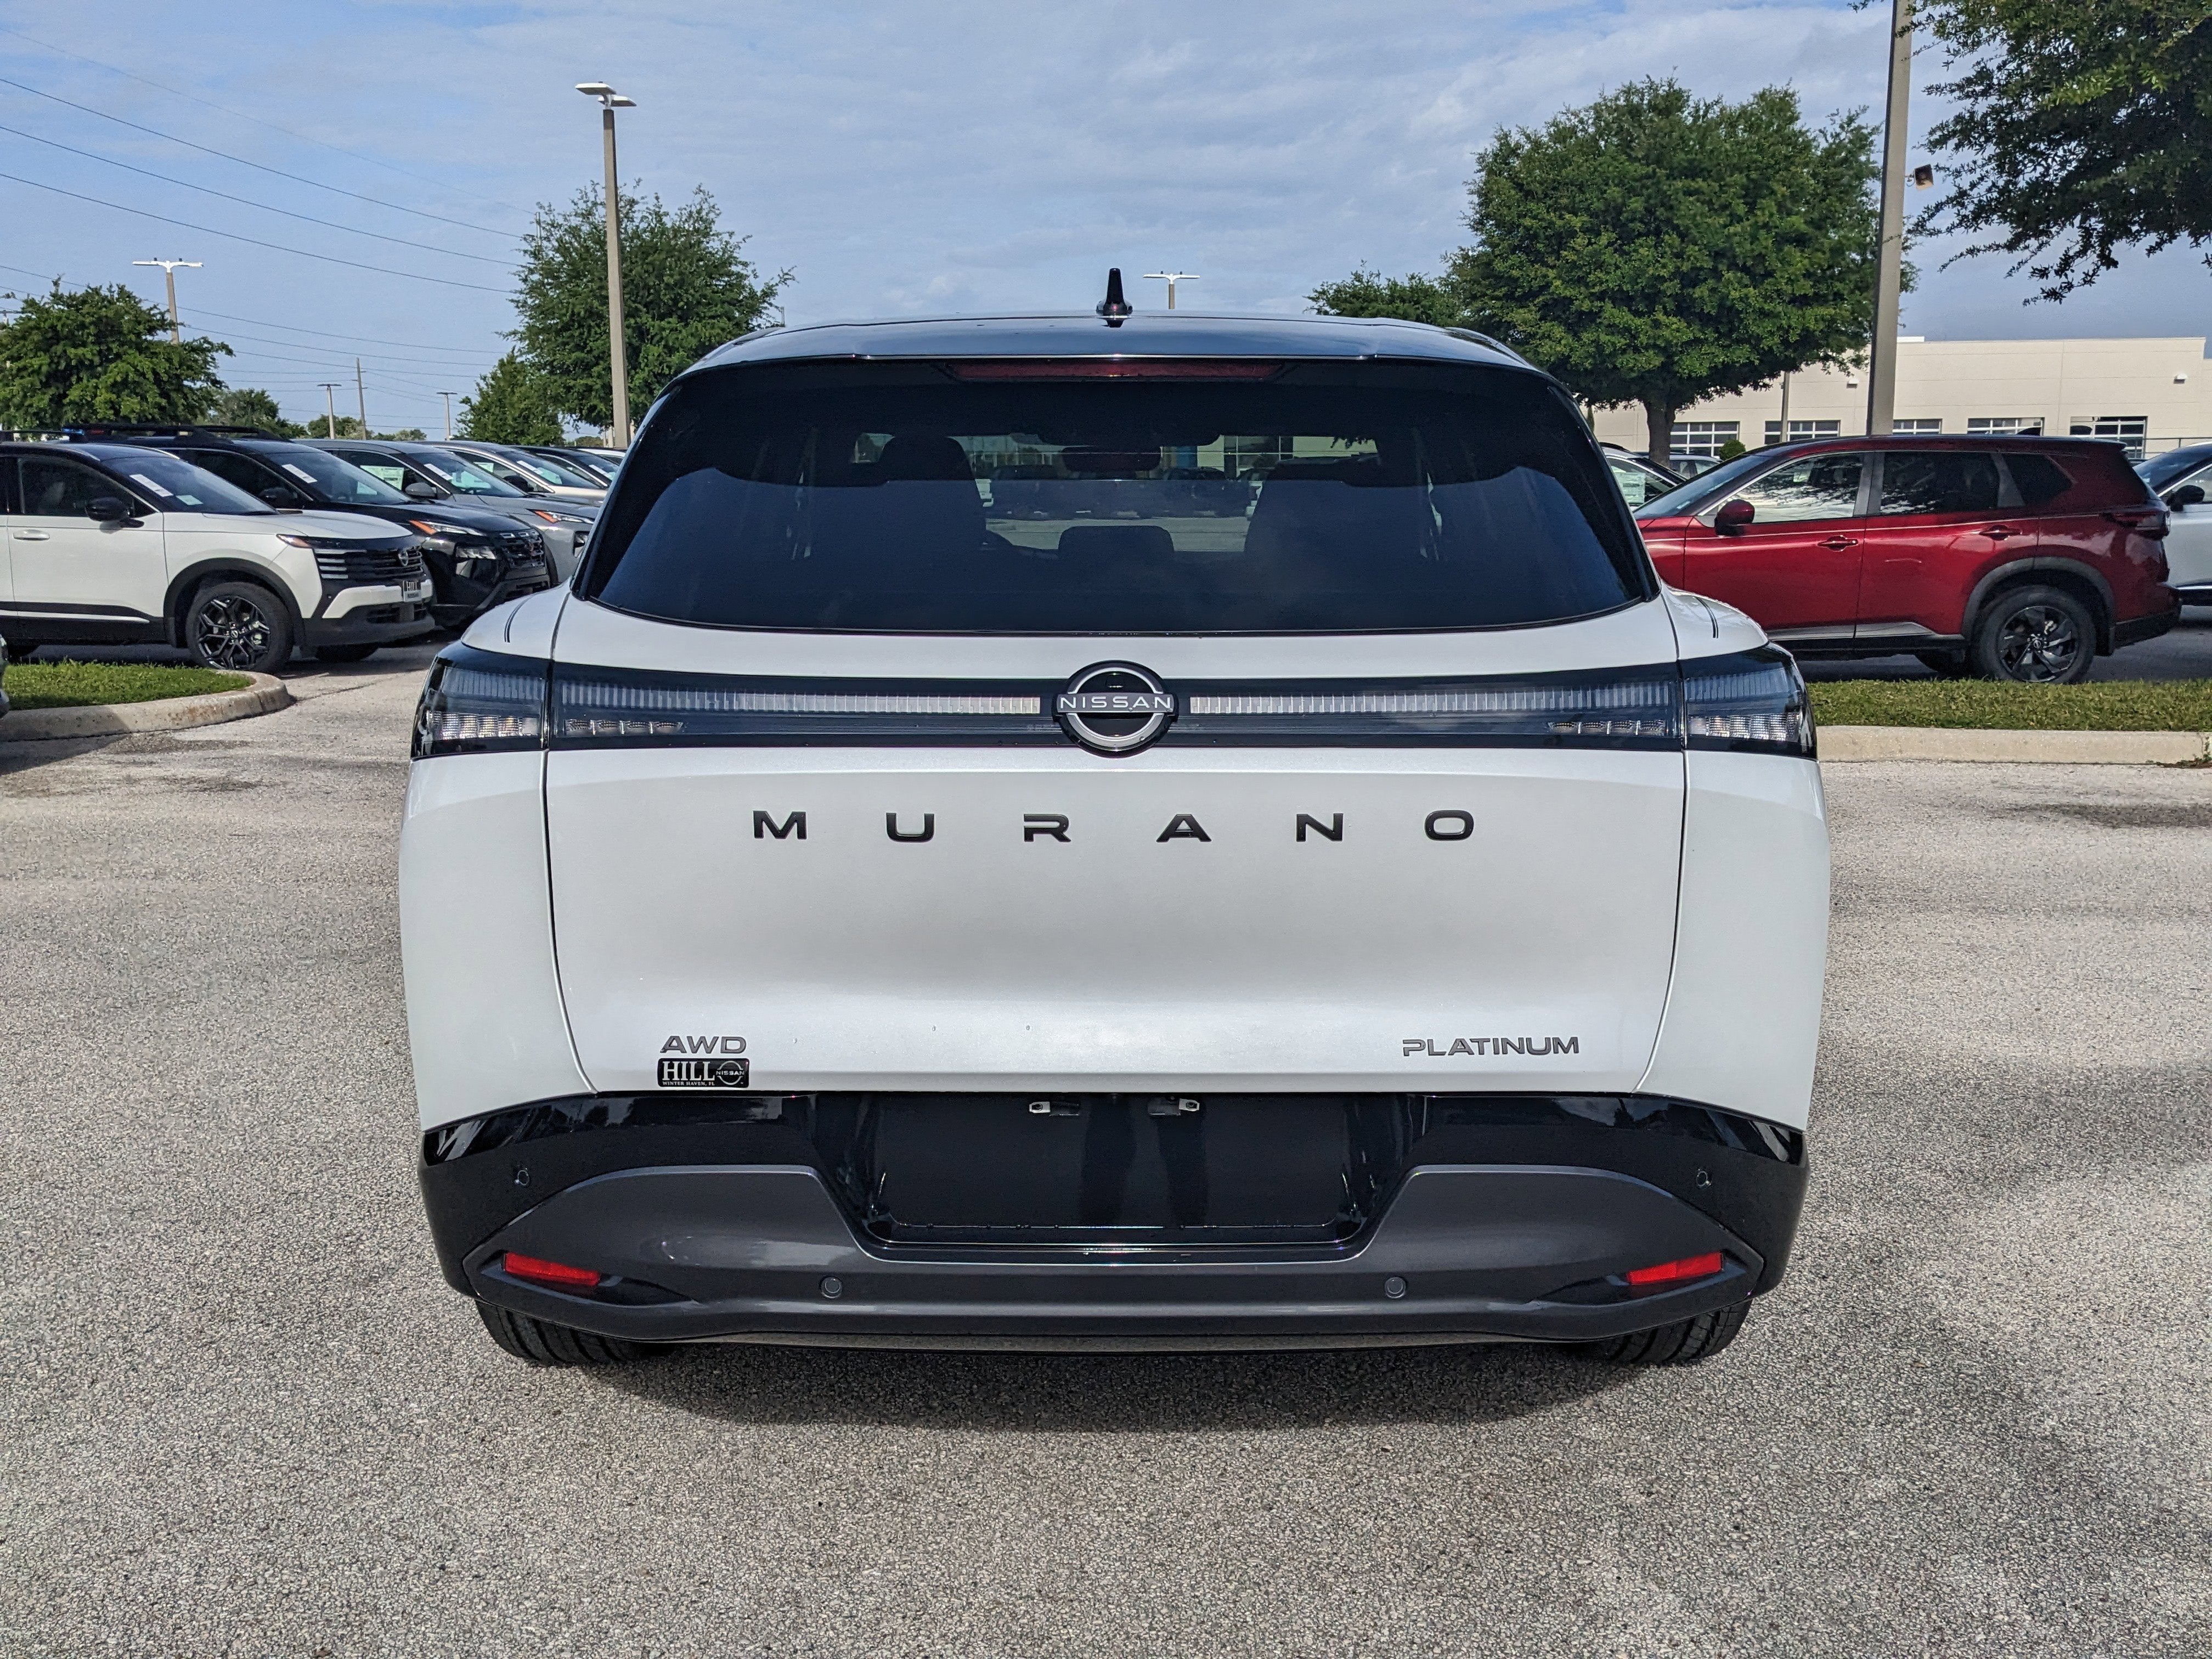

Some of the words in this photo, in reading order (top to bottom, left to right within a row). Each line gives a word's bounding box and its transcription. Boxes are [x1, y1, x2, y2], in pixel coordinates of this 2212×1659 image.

[1060, 696, 1171, 709] NISSAN
[753, 810, 1475, 843] MURANO
[659, 1035, 747, 1054] AWD
[1402, 1036, 1579, 1056] PLATINUM
[662, 1061, 715, 1081] HILL
